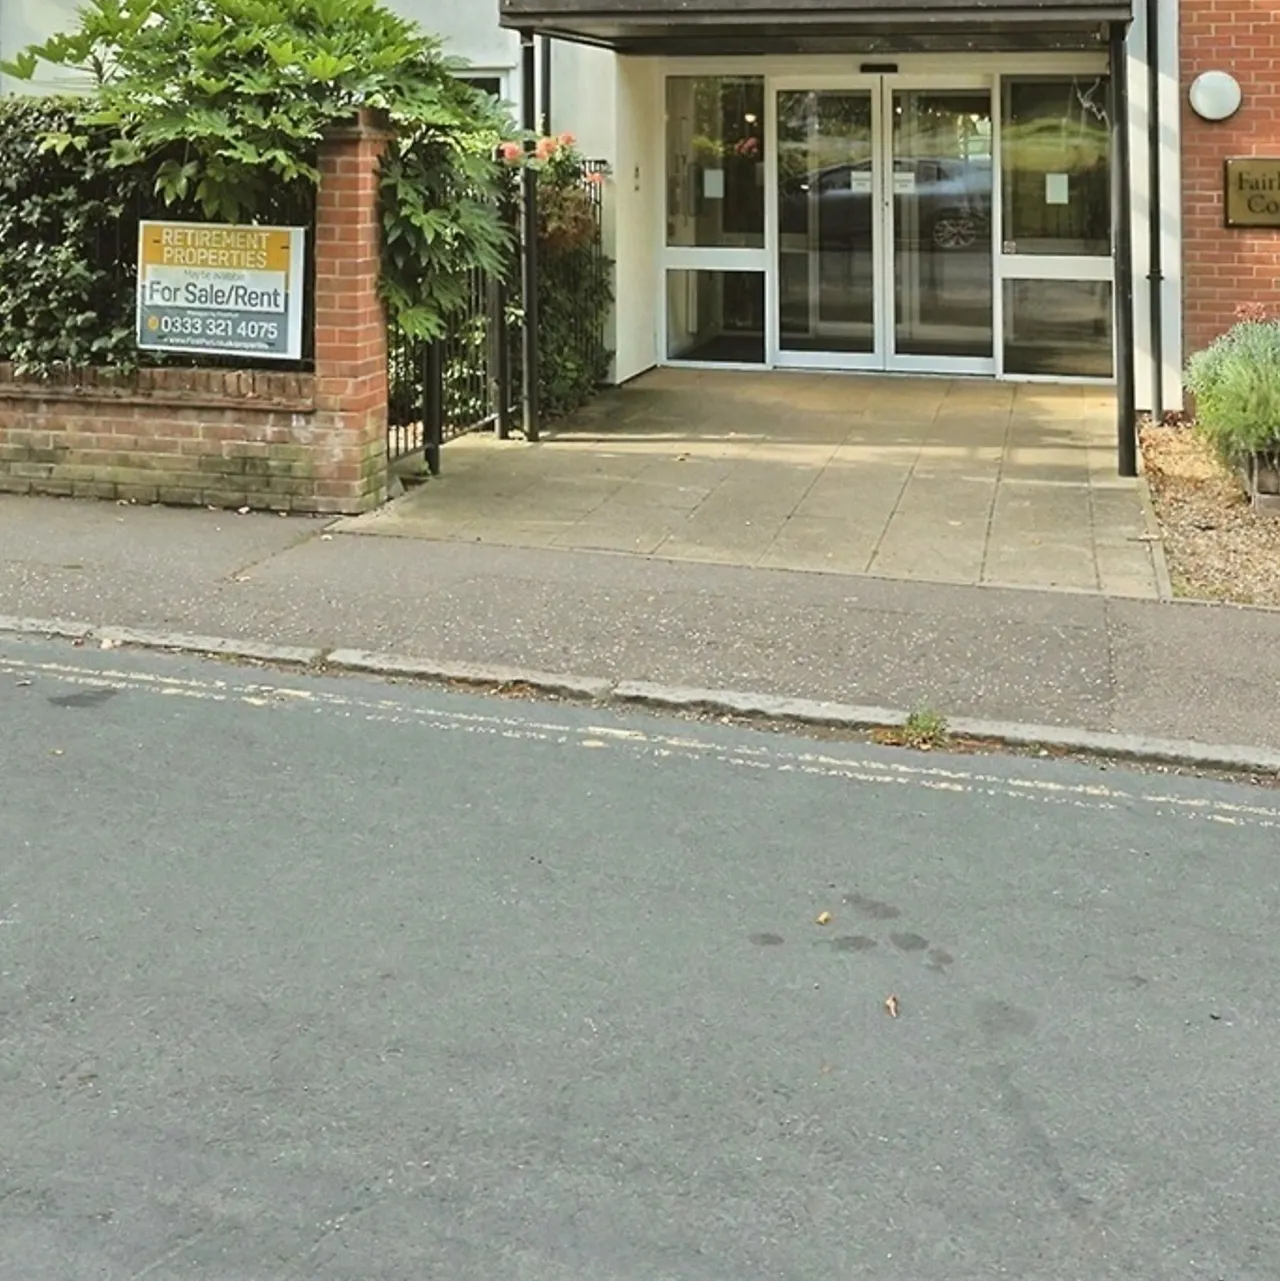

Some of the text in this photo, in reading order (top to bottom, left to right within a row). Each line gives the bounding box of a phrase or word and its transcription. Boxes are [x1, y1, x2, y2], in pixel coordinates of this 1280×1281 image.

[161, 227, 269, 250] RETIREMENT
[163, 246, 268, 268] PROPERTIES
[148, 281, 281, 308] For Sale/Rent
[161, 315, 278, 339] 0333 321 4075
